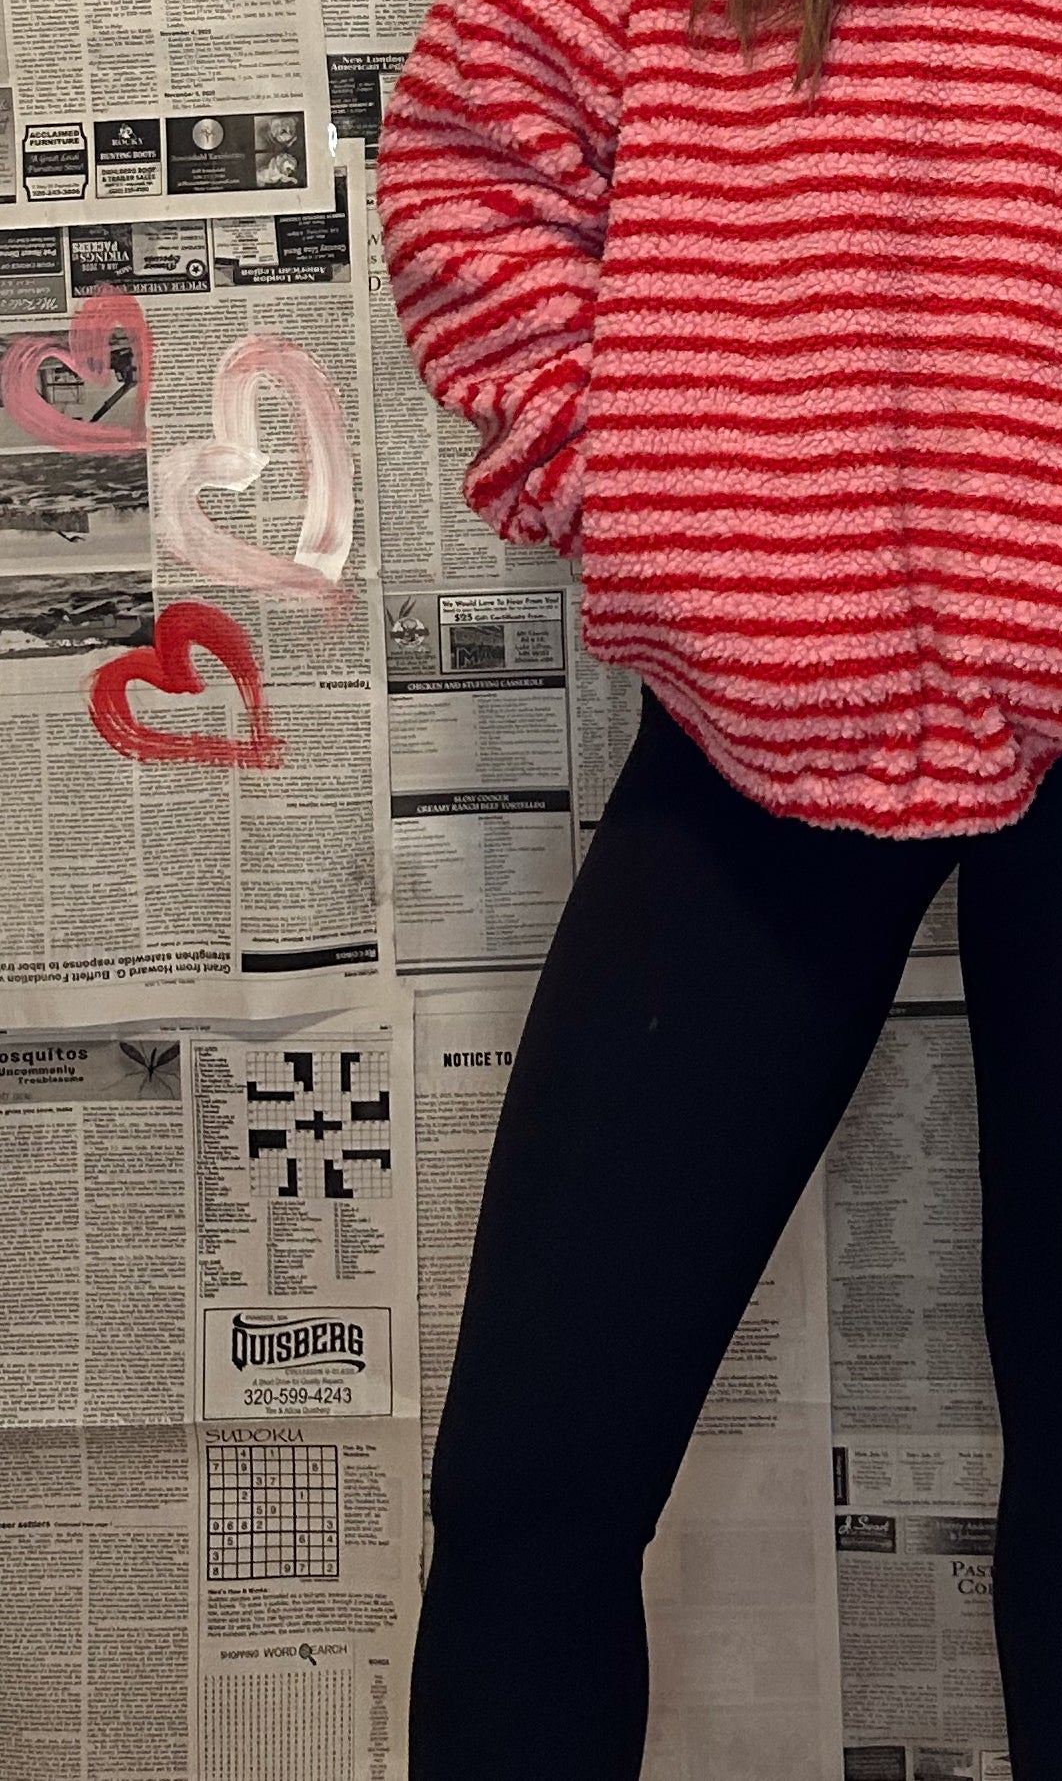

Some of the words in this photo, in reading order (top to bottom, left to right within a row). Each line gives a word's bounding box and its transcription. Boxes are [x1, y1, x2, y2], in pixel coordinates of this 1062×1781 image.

[0, 1047, 88, 1063] osquitos
[443, 1051, 491, 1067] NOTICE
[494, 1050, 513, 1066] TO
[231, 1322, 364, 1371] QUISBERG
[243, 1386, 352, 1405] 320-599-4243
[205, 1428, 304, 1443] SUDOKU
